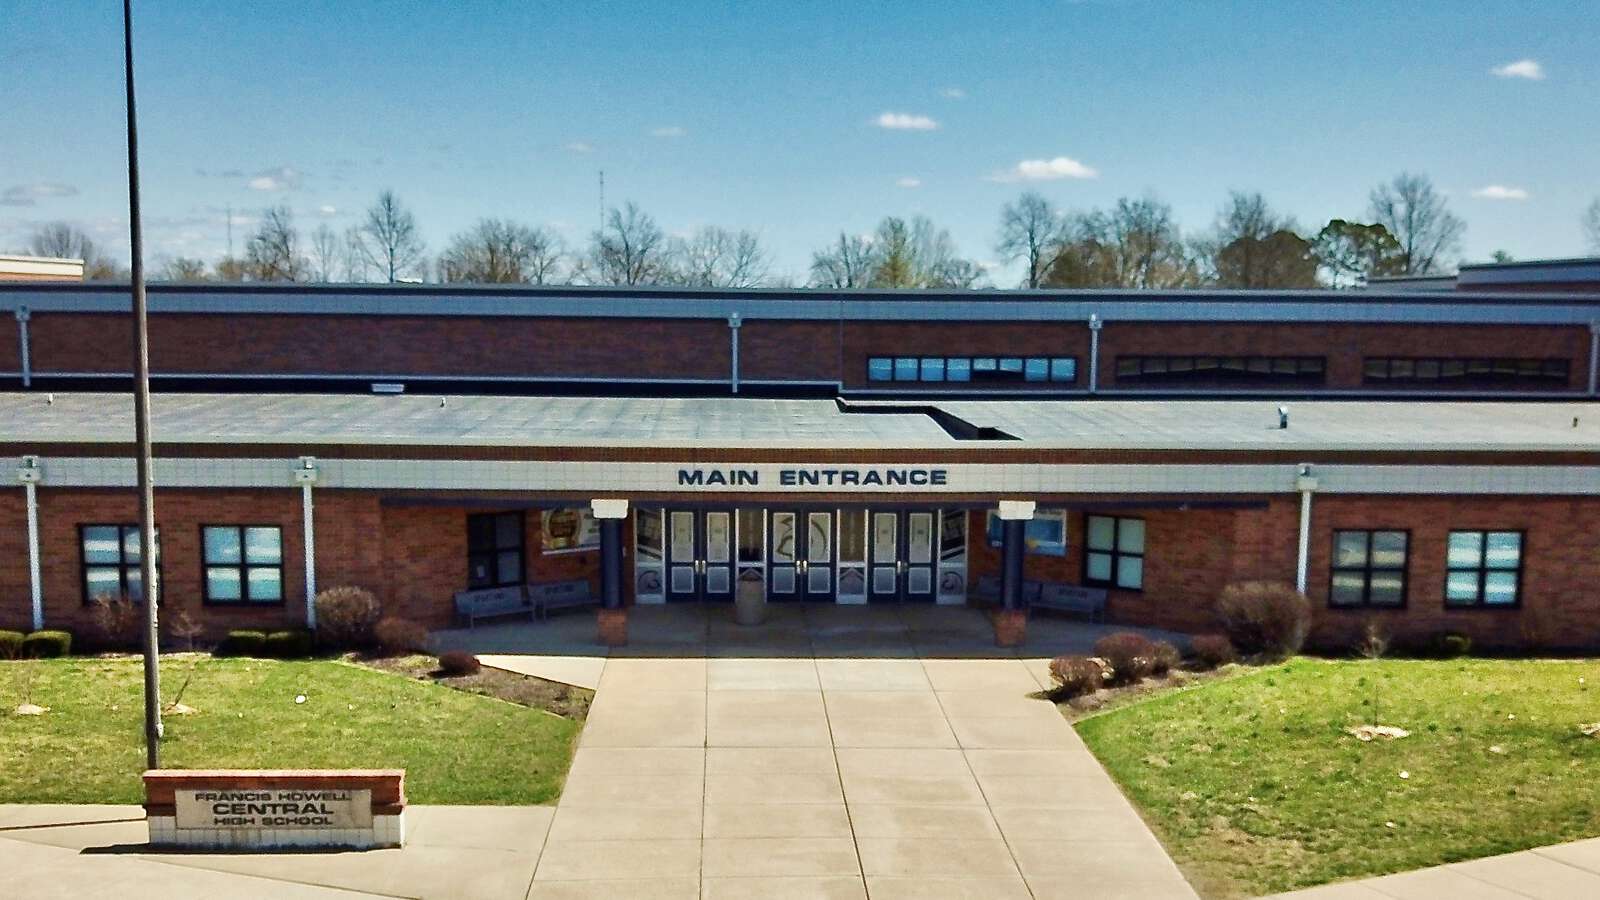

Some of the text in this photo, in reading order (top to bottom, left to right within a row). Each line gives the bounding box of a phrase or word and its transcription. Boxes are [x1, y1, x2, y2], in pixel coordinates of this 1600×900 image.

[678, 470, 947, 485] MAIN ENTRANCE
[195, 792, 351, 802] FRANCIS HOWELL
[212, 802, 334, 815] CENTRAL
[214, 816, 333, 826] HIGH SCHOOL
